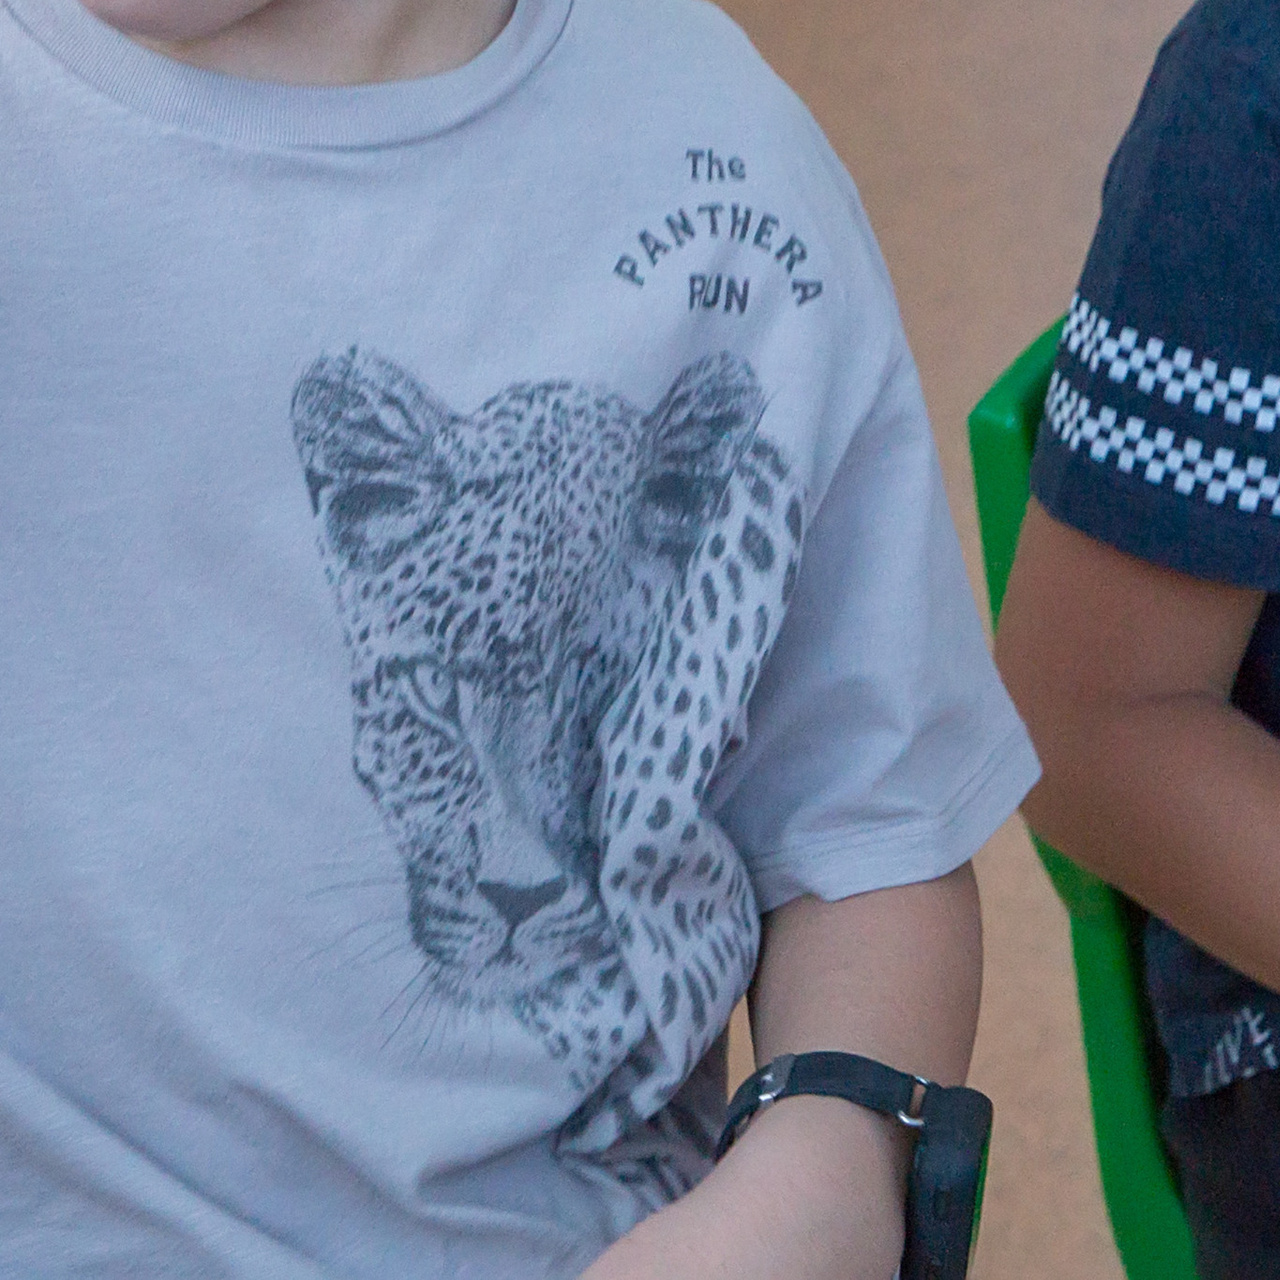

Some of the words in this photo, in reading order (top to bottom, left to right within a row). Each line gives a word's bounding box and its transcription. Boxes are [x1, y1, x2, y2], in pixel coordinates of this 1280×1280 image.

[686, 148, 746, 181] The
[613, 202, 823, 307] PANTHERA
[688, 273, 750, 314] RUN
